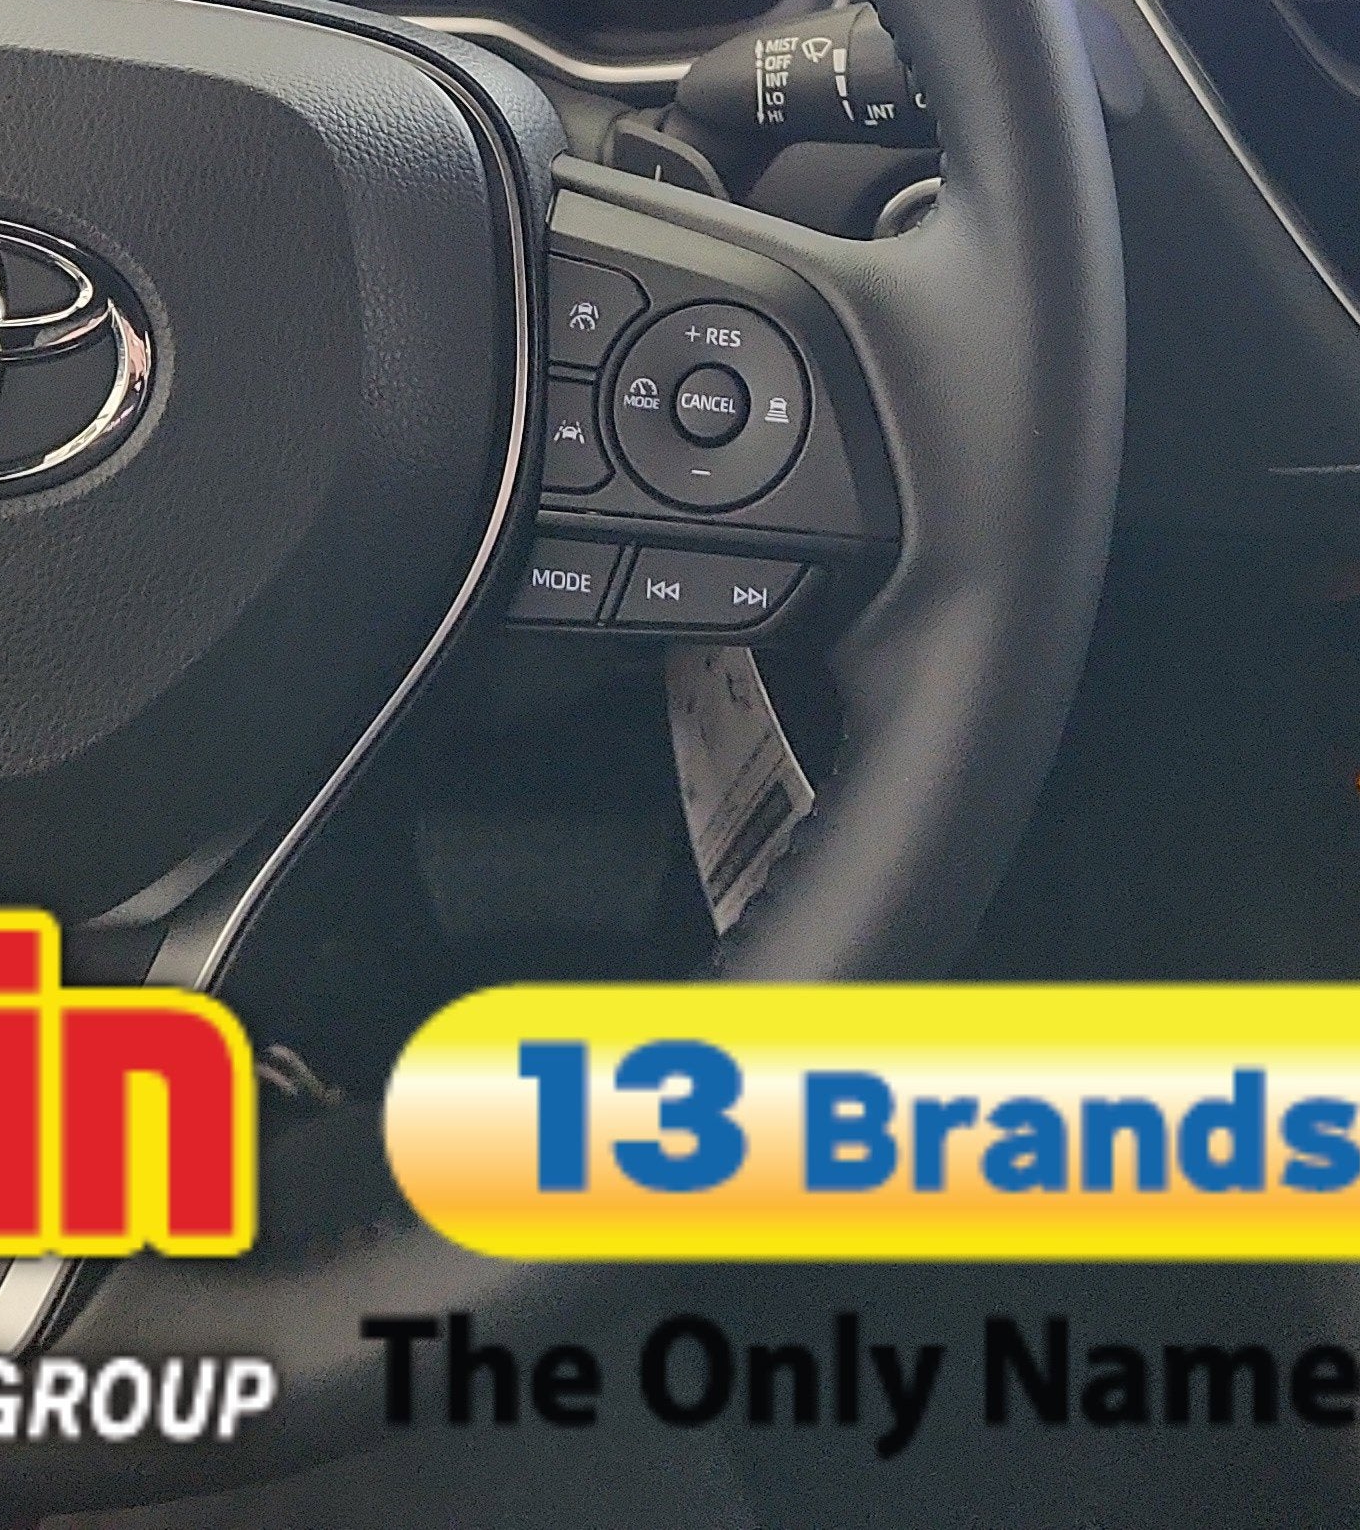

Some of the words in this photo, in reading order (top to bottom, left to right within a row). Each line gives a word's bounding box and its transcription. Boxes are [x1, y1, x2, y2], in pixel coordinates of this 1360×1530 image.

[765, 37, 799, 53] MIST
[765, 55, 792, 71] OFF
[766, 72, 789, 87] INT
[766, 91, 784, 106] LO
[866, 103, 895, 121] INT
[705, 327, 741, 348] RES
[623, 394, 660, 410] MODE
[681, 392, 736, 414] CANCEL
[531, 568, 592, 594] MODE
